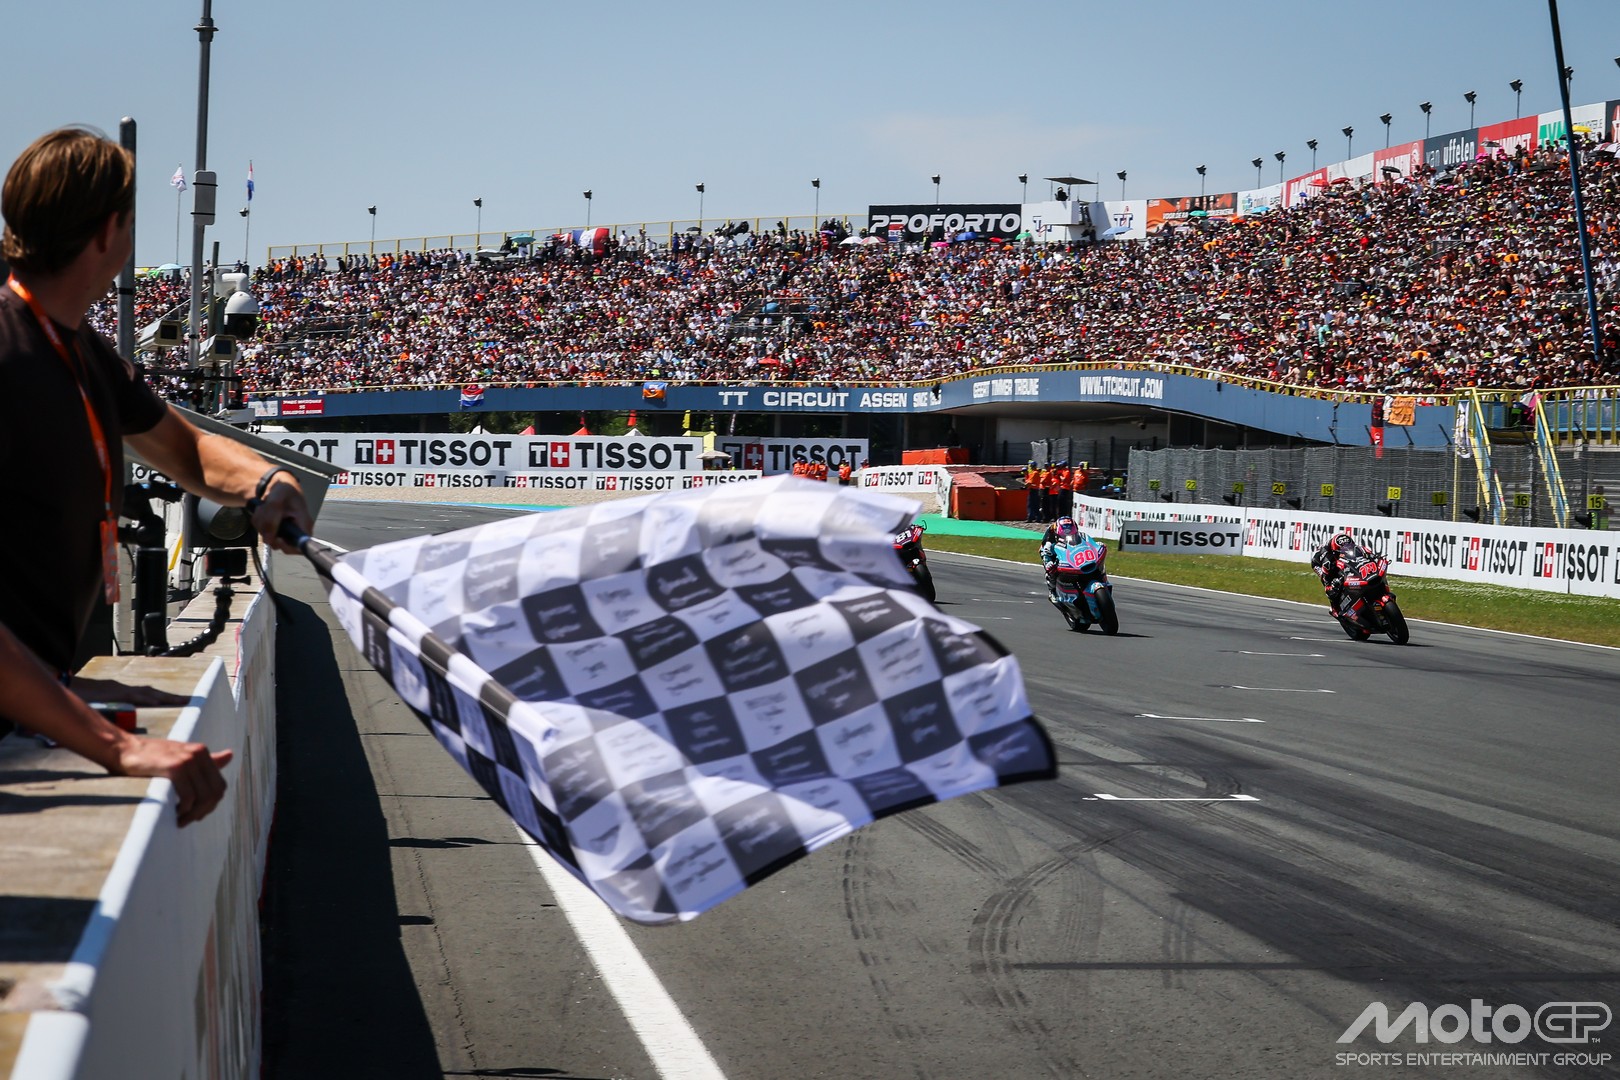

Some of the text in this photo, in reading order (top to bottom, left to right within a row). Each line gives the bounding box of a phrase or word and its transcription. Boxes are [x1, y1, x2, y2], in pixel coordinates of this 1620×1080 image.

[1443, 136, 1475, 165] uffelen
[869, 213, 1021, 233] PROFORTO
[718, 391, 748, 406] TT
[763, 391, 849, 407] CIRCUIT
[859, 392, 907, 408] ASSEN
[399, 439, 512, 466] TISSOT
[575, 442, 693, 470] TISSOT
[767, 444, 862, 471] TISSOT
[351, 472, 406, 487] TISSOT
[437, 474, 496, 488] TISSOT
[529, 476, 588, 489] TISSOT
[619, 476, 674, 491] TISSOT
[879, 472, 914, 487] TISSOT
[1273, 483, 1285, 493] 20
[1323, 485, 1333, 496] 19
[1390, 488, 1400, 499] 18
[1515, 495, 1528, 506] 16
[1590, 496, 1601, 509] 15
[1158, 530, 1240, 547] TISSOT
[1255, 519, 1286, 549] TISSOT
[1074, 549, 1095, 567] 80
[1412, 531, 1457, 568] TISSOT
[1481, 538, 1528, 576] TISSOT
[1556, 543, 1610, 583] TISSOT
